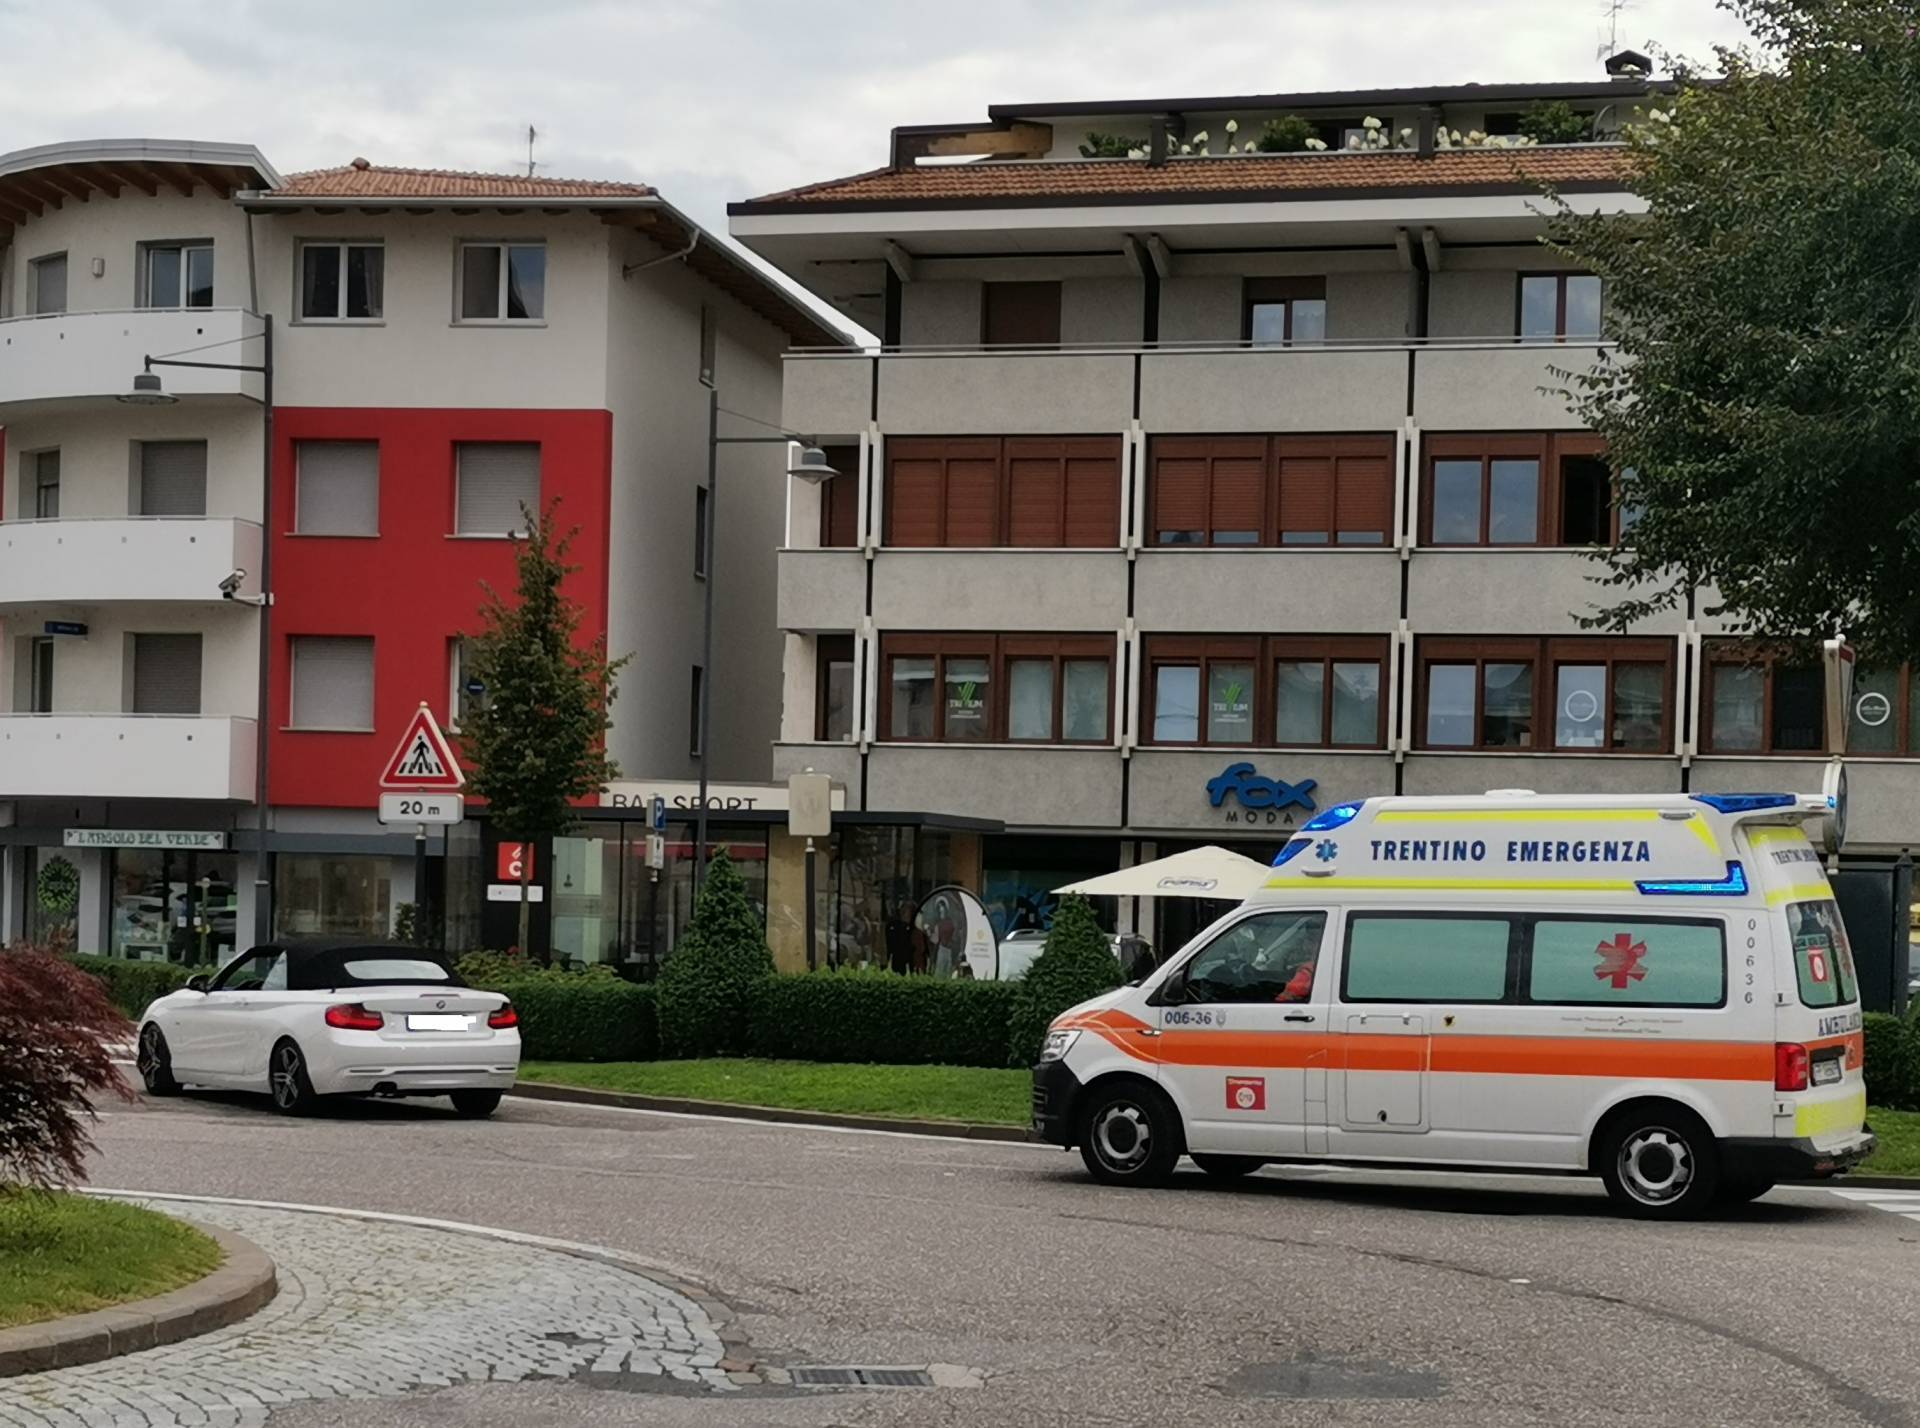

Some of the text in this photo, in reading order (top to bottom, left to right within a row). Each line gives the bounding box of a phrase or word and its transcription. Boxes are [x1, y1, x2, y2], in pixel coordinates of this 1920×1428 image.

[400, 801, 440, 815] 20 m
[1225, 811, 1294, 824] MODA
[138, 832, 162, 844] DEL
[1371, 840, 1651, 862] TRENTINO EMERGENZA
[1164, 1011, 1212, 1025] 006-36
